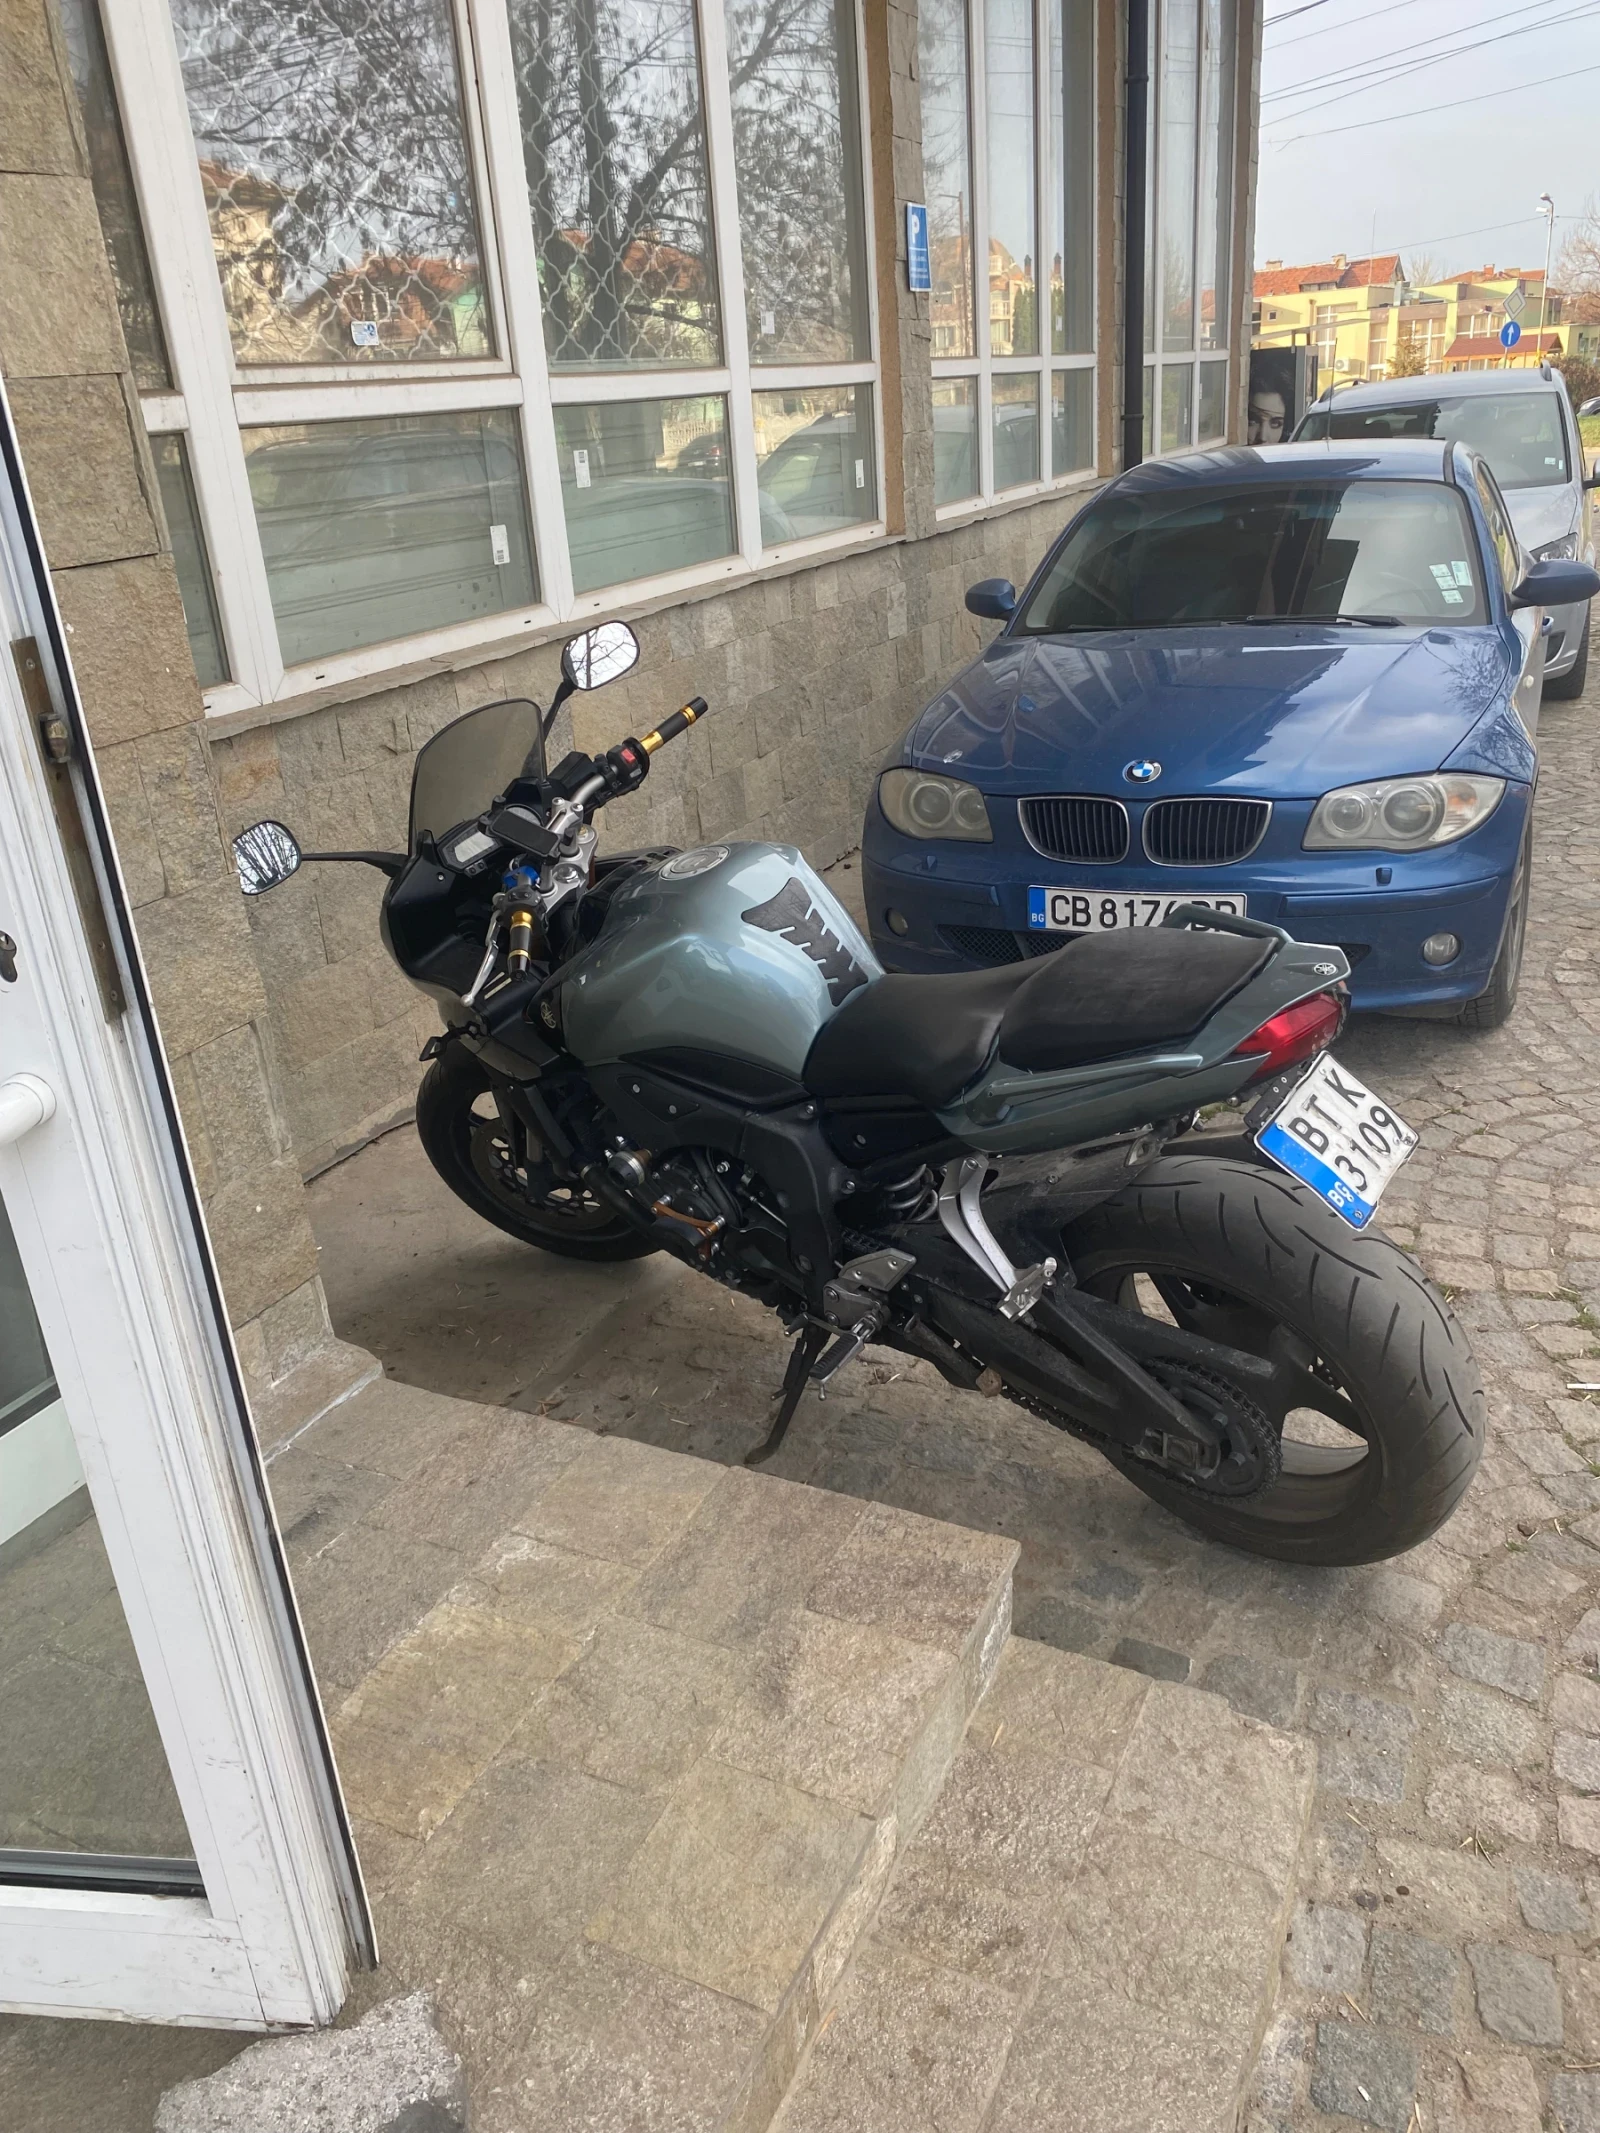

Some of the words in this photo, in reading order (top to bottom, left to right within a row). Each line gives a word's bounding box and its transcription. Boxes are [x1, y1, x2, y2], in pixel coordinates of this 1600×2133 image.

[1031, 913, 1044, 923] BG
[1051, 895, 1091, 926] CB
[1334, 1105, 1404, 1192] 3109
[1327, 1181, 1354, 1208] BG
